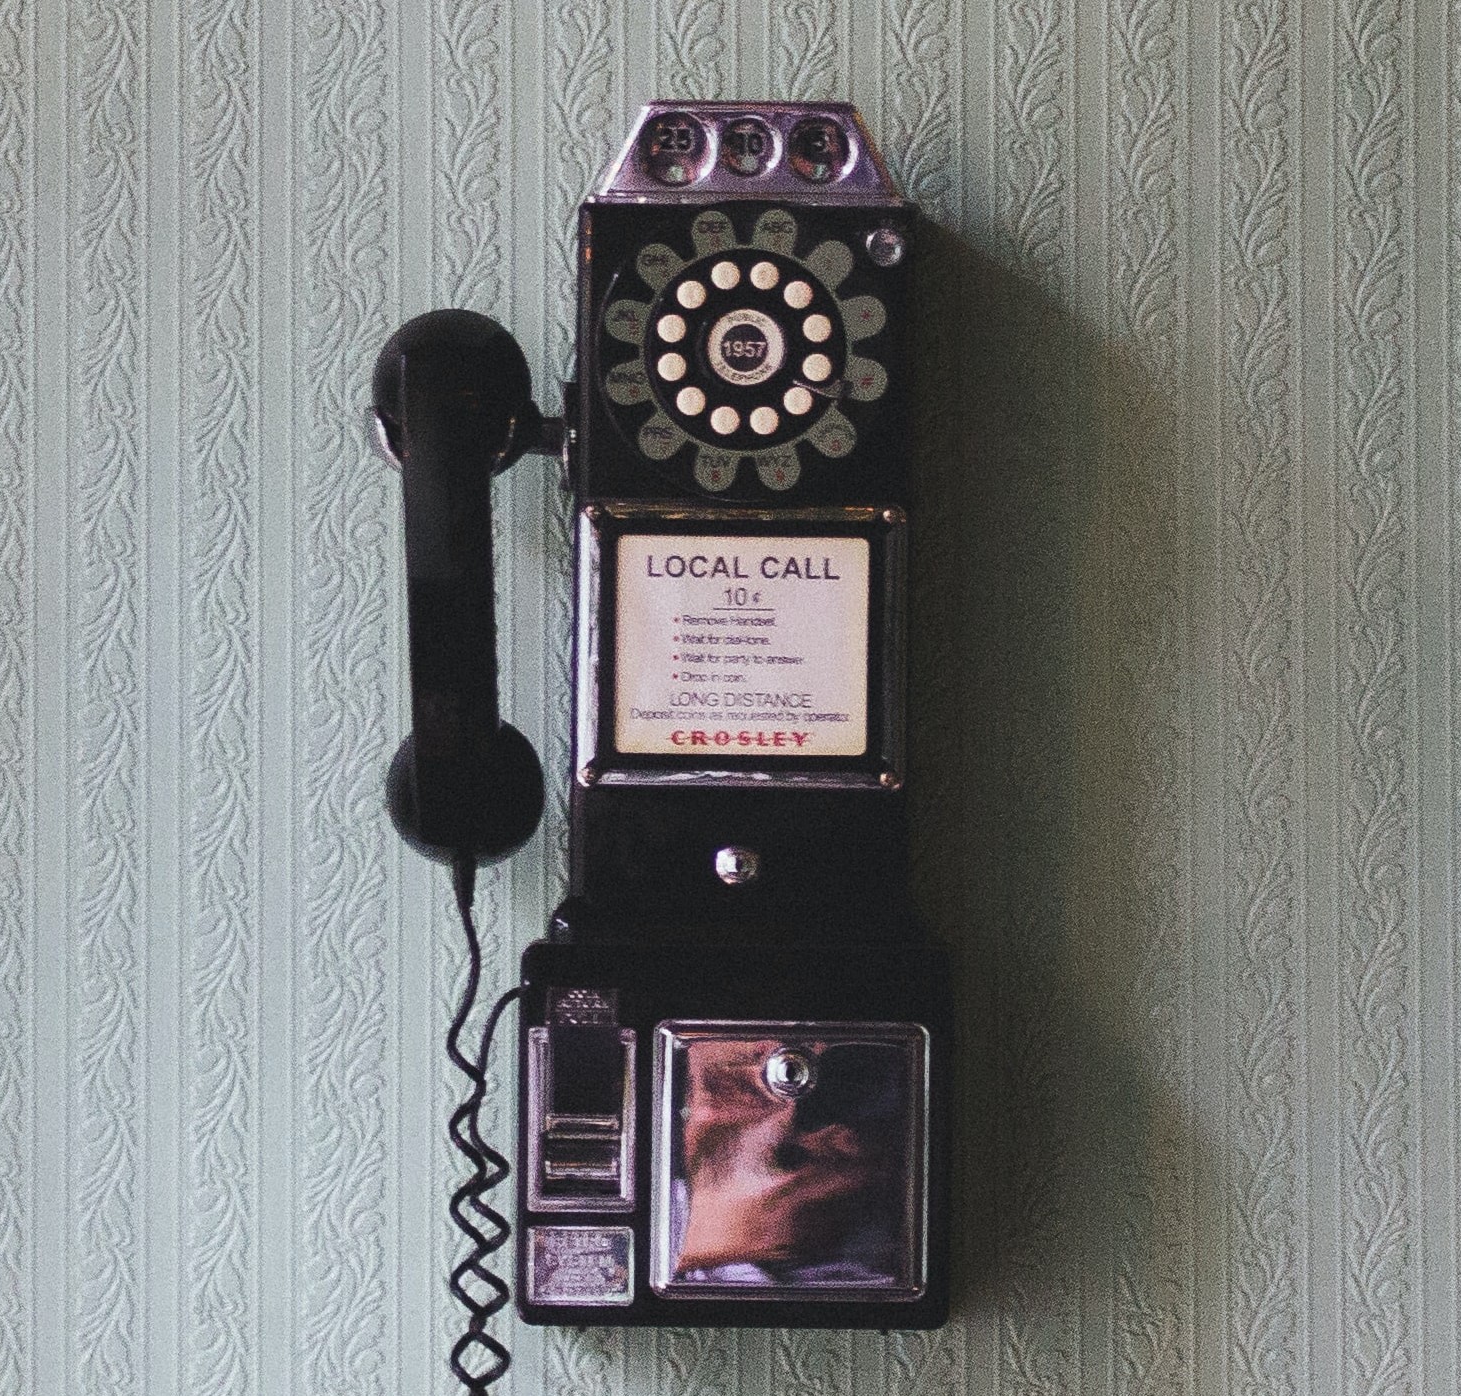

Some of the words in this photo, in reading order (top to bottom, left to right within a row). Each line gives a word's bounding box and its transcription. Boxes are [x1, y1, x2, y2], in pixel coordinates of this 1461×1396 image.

[661, 129, 694, 151] 25
[737, 133, 764, 155] 10
[697, 221, 727, 234] DEF
[762, 221, 794, 234] ABC
[722, 340, 766, 359] 1957
[647, 555, 749, 578] LOCAL
[761, 556, 840, 580] CALL
[724, 588, 748, 606] 10
[682, 614, 727, 626] Remove
[681, 634, 705, 645] Wait
[707, 634, 721, 645] for
[680, 653, 705, 663] Wait
[707, 653, 721, 663] for
[723, 655, 750, 667] party
[752, 655, 763, 664] to
[681, 671, 708, 683] Drop
[711, 673, 721, 682] in
[669, 691, 718, 708] LONG
[723, 692, 812, 709] DISTANCE
[629, 707, 673, 721] Deposit
[676, 710, 705, 720] coins
[709, 711, 724, 721] as
[728, 711, 782, 722] requested
[784, 711, 799, 725] by
[668, 729, 811, 748] CROSLEY
